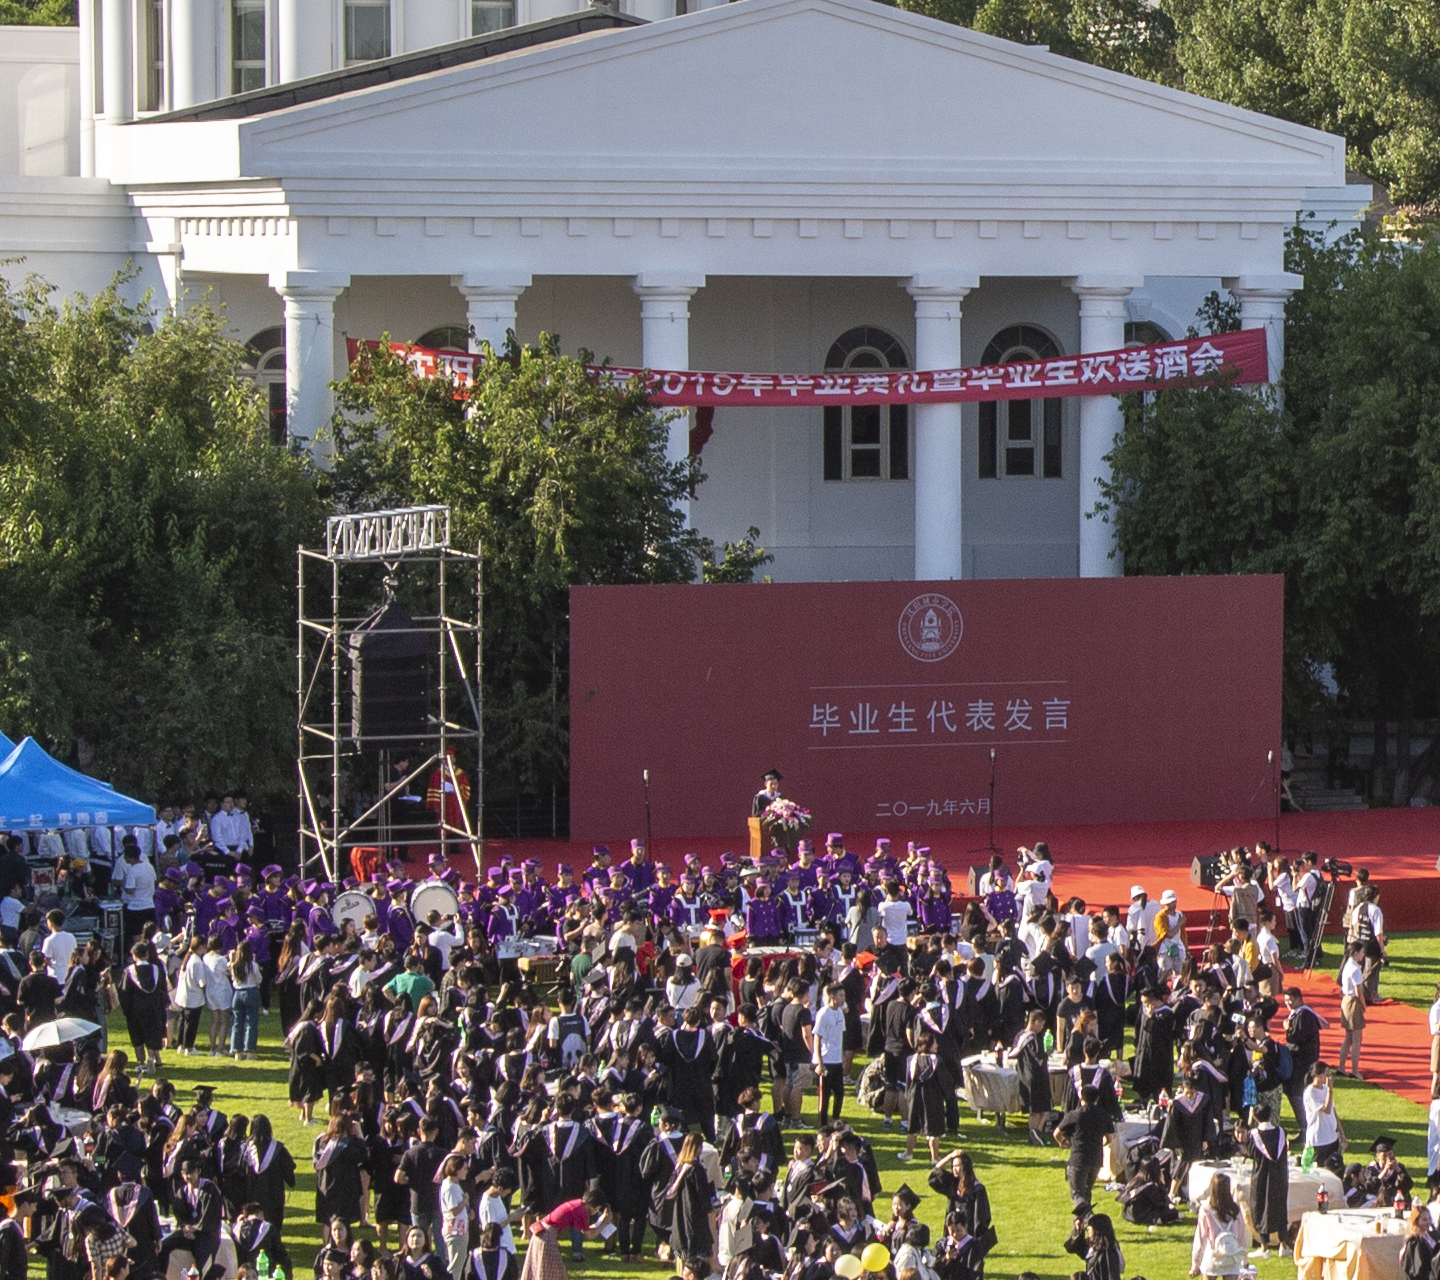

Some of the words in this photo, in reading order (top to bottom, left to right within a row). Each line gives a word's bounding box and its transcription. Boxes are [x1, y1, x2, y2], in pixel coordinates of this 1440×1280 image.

[396, 341, 1224, 398] 沈阳2019年毕业典礼暨毕业生欢送酒会
[809, 697, 1071, 737] 毕业生代表发言
